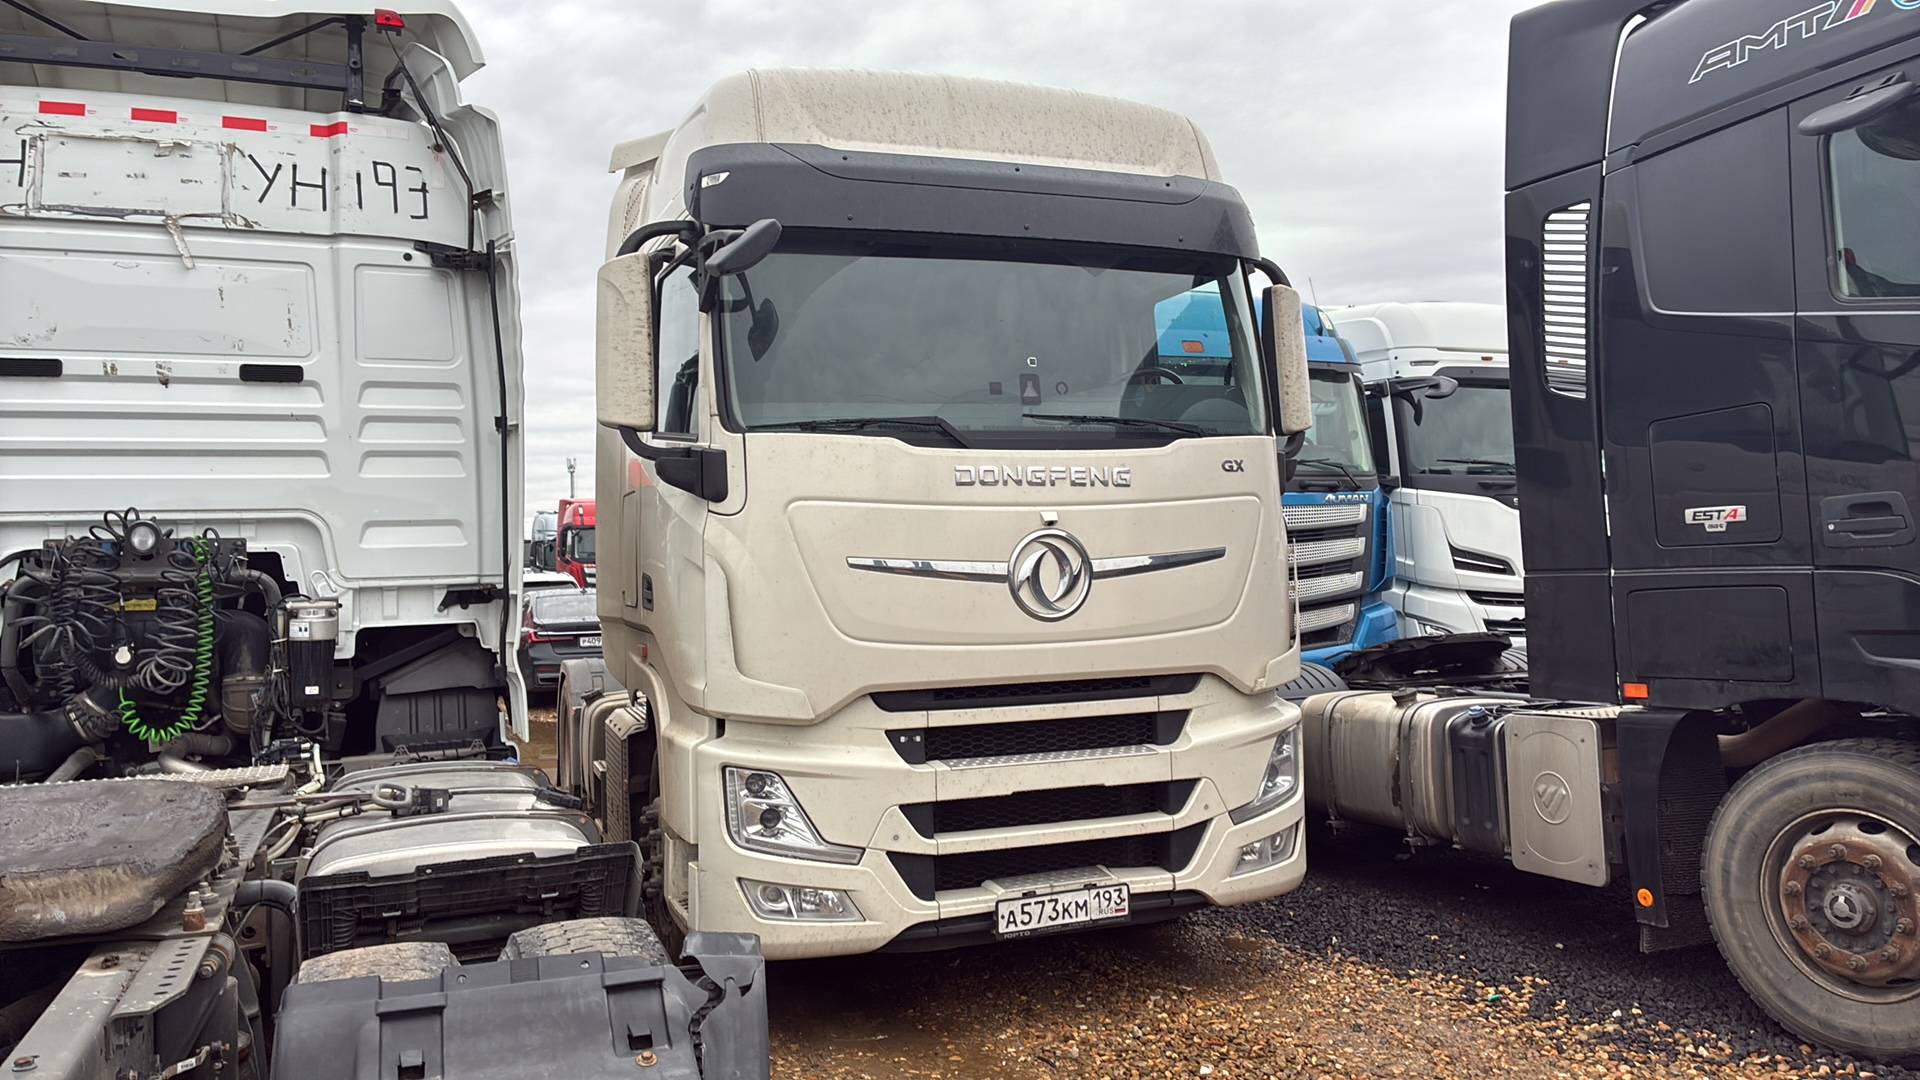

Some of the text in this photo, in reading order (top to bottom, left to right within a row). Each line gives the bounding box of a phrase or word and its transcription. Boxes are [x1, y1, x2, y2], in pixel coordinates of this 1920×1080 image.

[1221, 459, 1245, 472] GX
[954, 464, 1132, 487] DONGFENG
[1692, 508, 1738, 521] ESTA
[1093, 888, 1123, 909] 193
